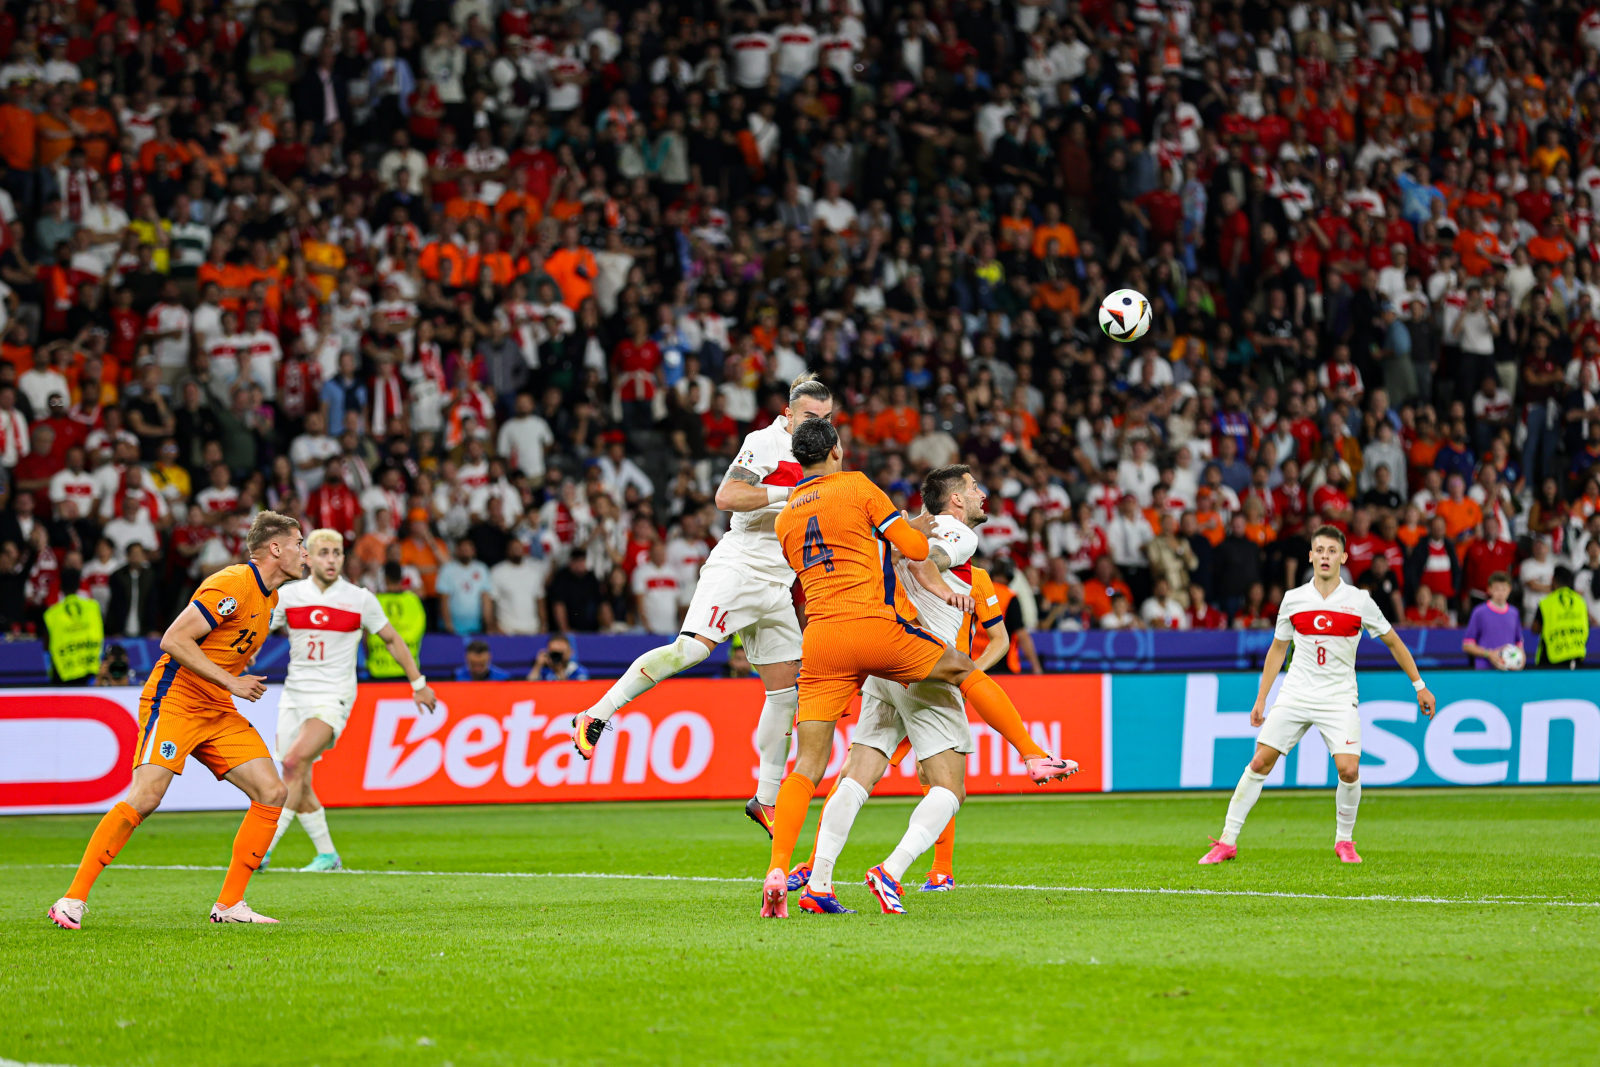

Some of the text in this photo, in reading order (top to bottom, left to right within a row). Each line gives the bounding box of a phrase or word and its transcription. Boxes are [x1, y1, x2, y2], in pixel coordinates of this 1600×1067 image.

[791, 489, 820, 509] VIRGIL
[803, 515, 835, 573] 4
[708, 605, 729, 633] 14
[230, 629, 257, 654] 15
[307, 640, 324, 661] 21
[1317, 646, 1326, 667] 8
[363, 698, 714, 791] Betano
